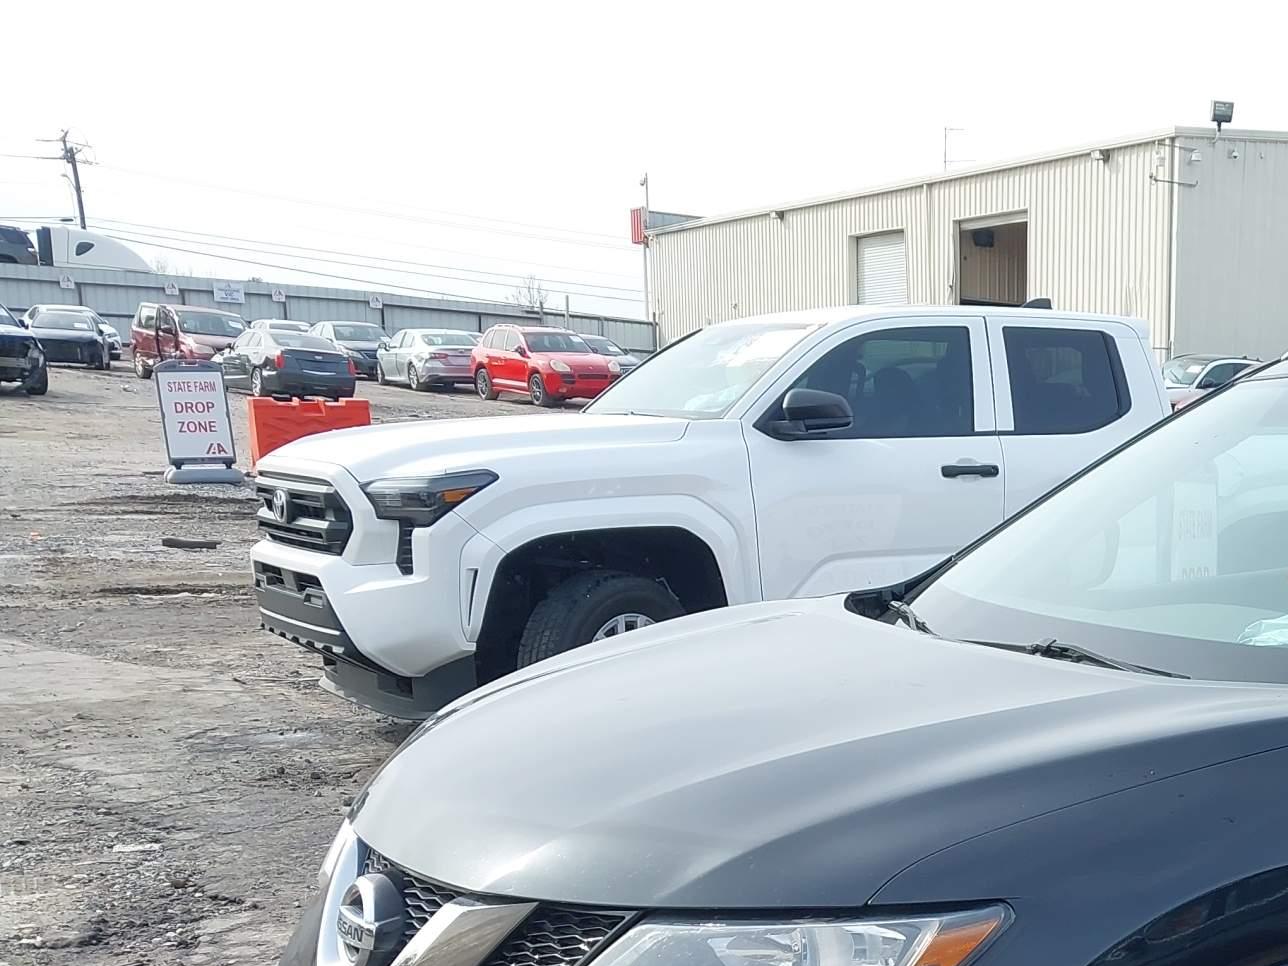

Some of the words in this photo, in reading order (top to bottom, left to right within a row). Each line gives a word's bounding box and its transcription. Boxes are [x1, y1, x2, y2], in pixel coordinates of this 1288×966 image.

[167, 381, 193, 393] STATE
[194, 381, 217, 393] FARM
[174, 401, 215, 414] DROP
[177, 420, 217, 433] ZONE
